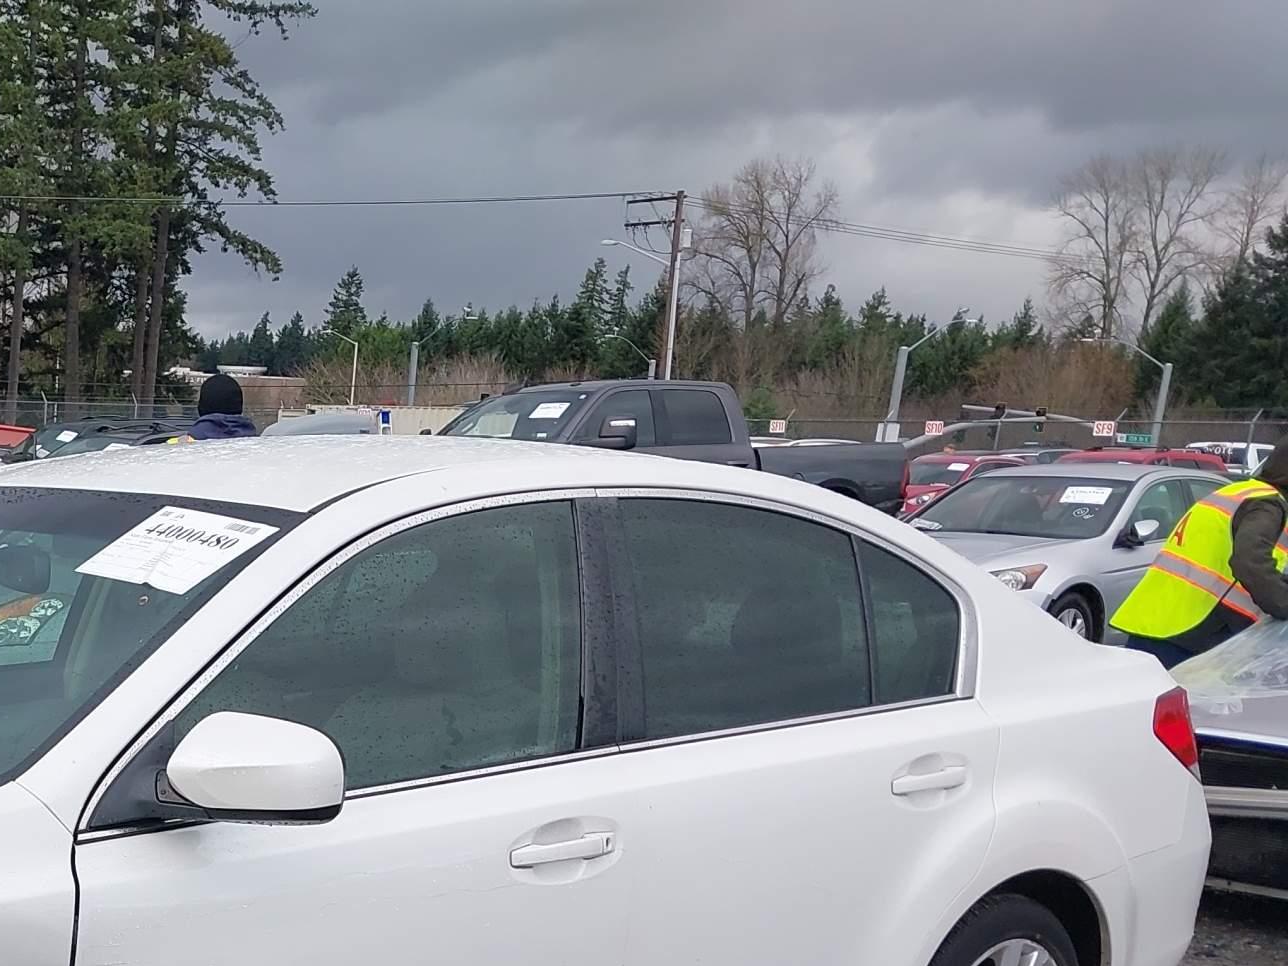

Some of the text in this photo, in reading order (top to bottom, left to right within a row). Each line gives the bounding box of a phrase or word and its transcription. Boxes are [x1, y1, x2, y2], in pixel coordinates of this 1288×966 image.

[926, 422, 943, 434] SF10
[1095, 423, 1113, 435] SF9
[145, 523, 239, 550] 44000480
